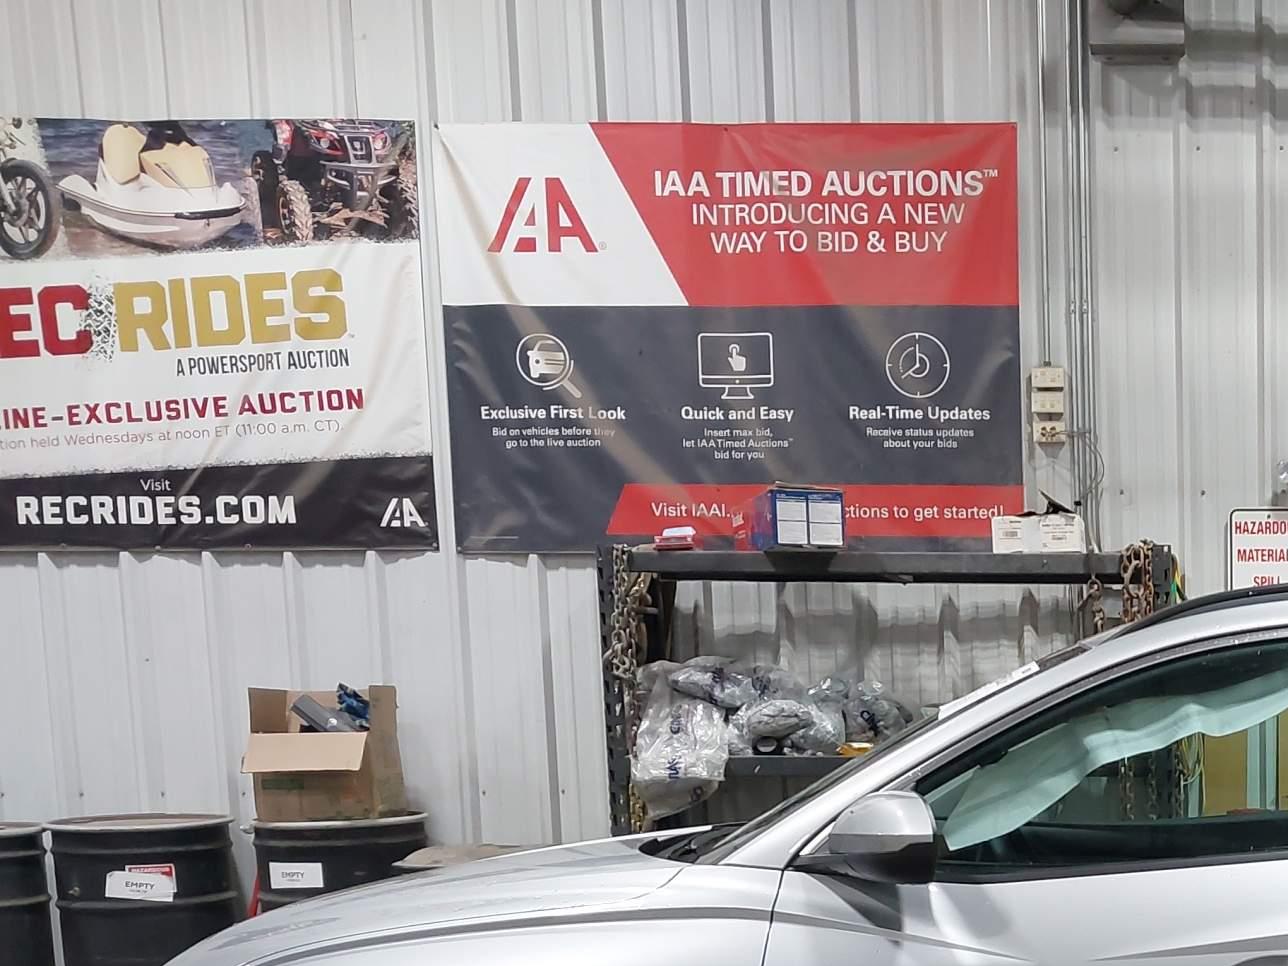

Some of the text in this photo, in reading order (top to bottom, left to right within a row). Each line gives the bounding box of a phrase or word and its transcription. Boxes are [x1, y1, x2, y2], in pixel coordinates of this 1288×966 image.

[654, 170, 711, 198] IAA
[715, 171, 812, 198] TIMED
[692, 202, 966, 226] INTRODUCING A NEW
[710, 230, 948, 254] WAY TO BID & BUY
[176, 348, 350, 377] A POWERSPORT AUCTION
[0, 388, 365, 430] INE-EXCLUSIVE AUCTION
[480, 405, 626, 420] Exclusive First Look
[681, 406, 794, 422] Quick and Easy
[848, 405, 991, 423] Real-Time Updates
[30, 436, 60, 448] held
[64, 431, 154, 446] Wednesdays
[158, 432, 171, 441] at
[175, 429, 210, 440] noon
[215, 426, 230, 438] ET
[235, 421, 276, 438] (11:00
[492, 427, 507, 436] Bid
[509, 428, 521, 436] on
[521, 427, 560, 436] vehicles
[561, 426, 592, 436] before
[704, 428, 773, 438] Insert max bid,
[866, 427, 975, 438] Receive status updates
[505, 438, 601, 449] go to the live auction
[682, 438, 695, 448] let
[697, 438, 716, 448] IAA
[717, 438, 746, 448] Timed
[883, 438, 958, 450] about your bids
[714, 450, 765, 461] bid for you
[140, 478, 171, 491] Visit
[15, 495, 298, 525] RECRIDES.COM
[651, 502, 688, 517] Visit
[893, 504, 909, 519] to
[913, 505, 939, 521] get
[125, 880, 155, 890] EMPTY
